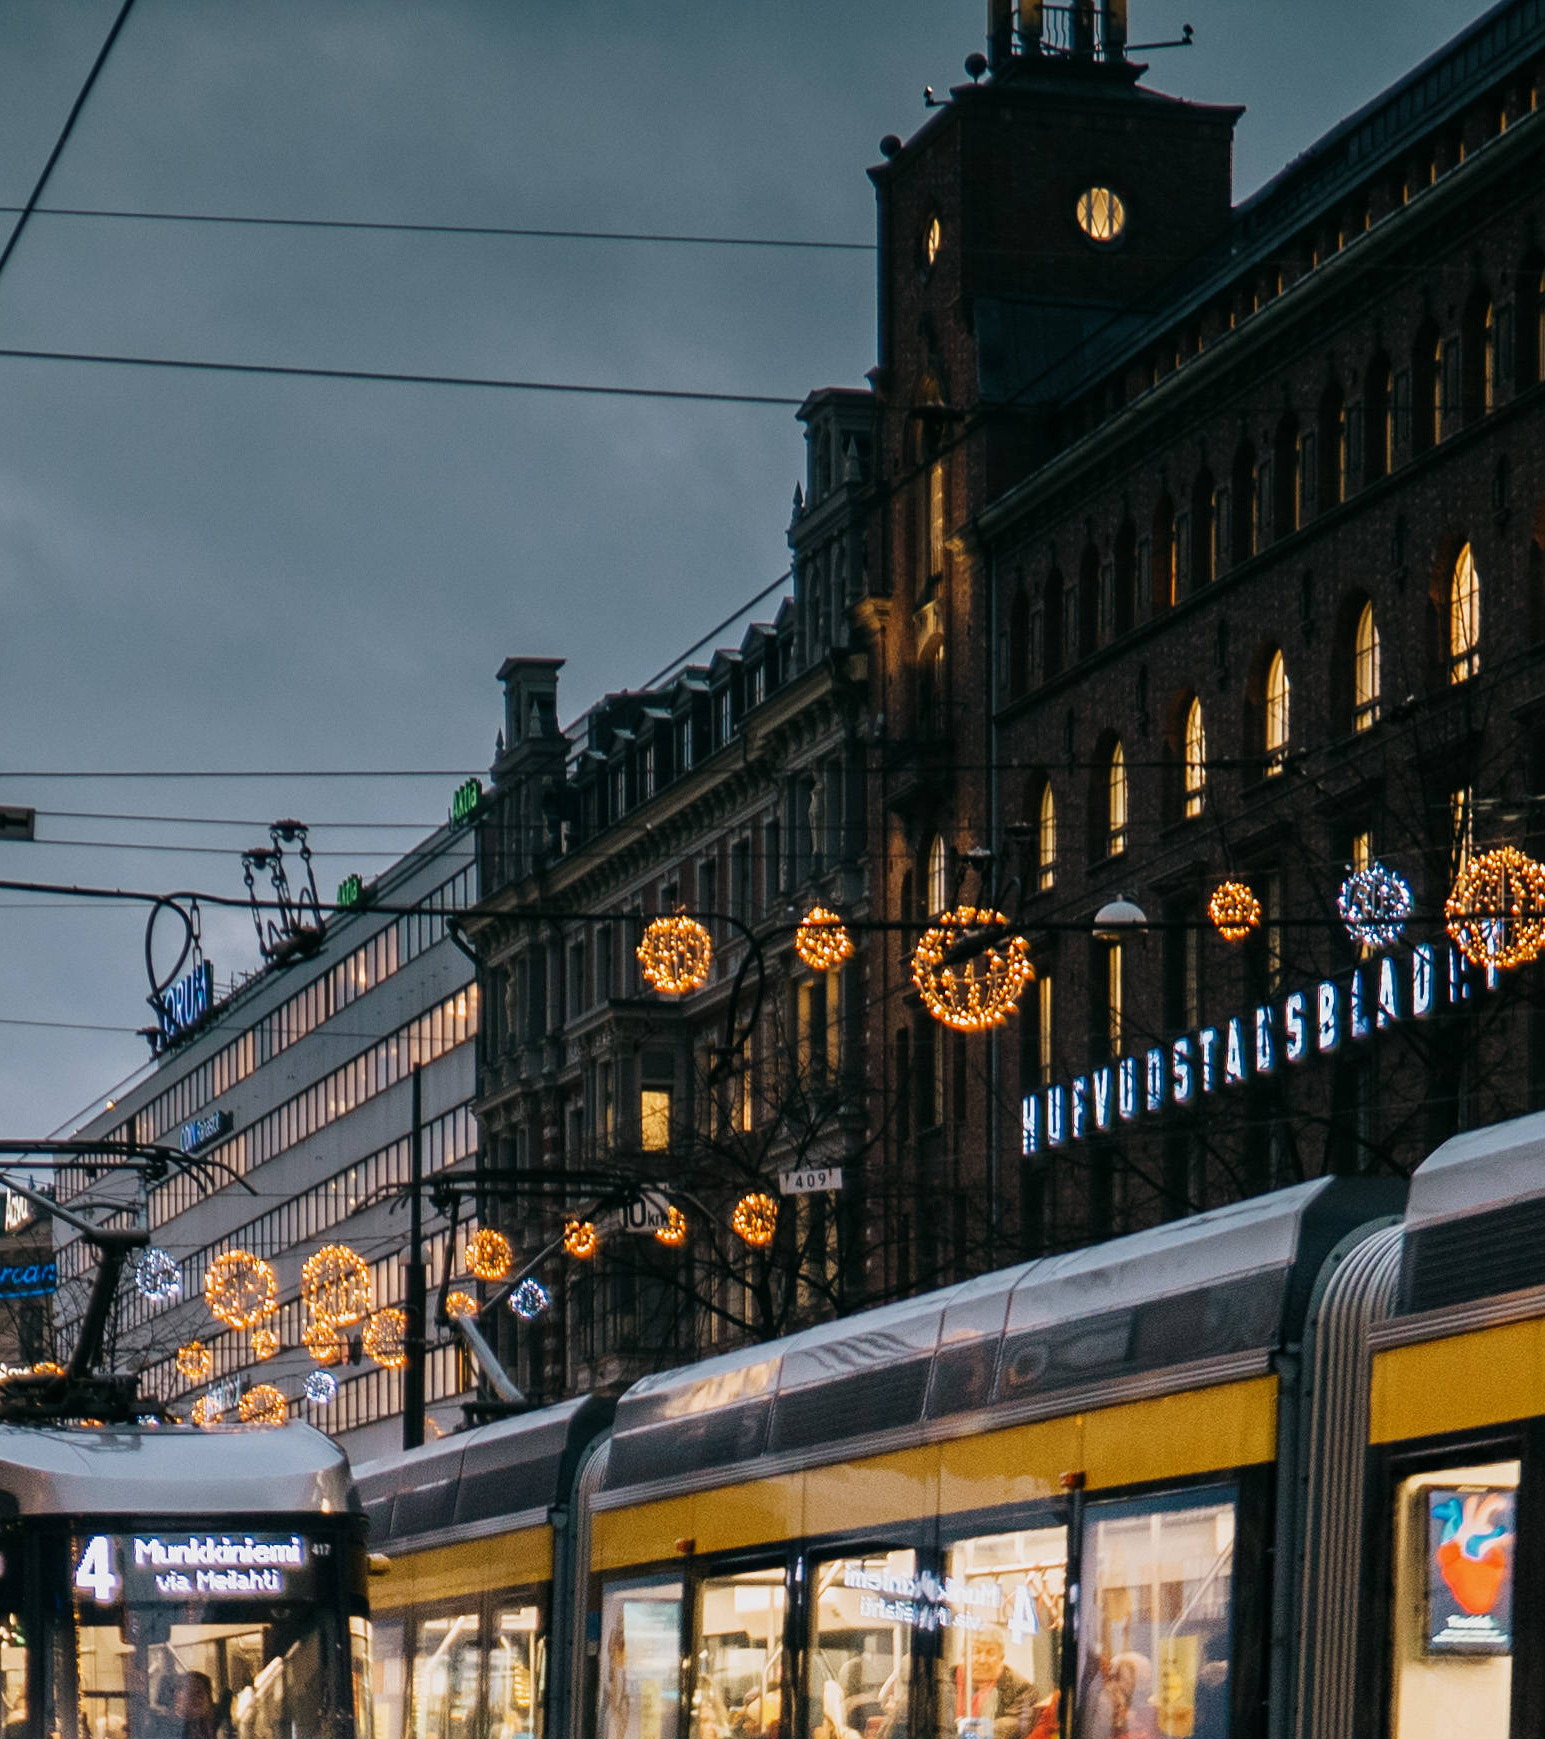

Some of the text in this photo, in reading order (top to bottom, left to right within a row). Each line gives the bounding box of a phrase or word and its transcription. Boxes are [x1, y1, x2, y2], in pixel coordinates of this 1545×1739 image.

[156, 966, 207, 1052] ORUM
[795, 1172, 827, 1188] 409
[76, 1535, 116, 1600] 4
[134, 1536, 303, 1564] Munkkiniemi
[156, 1569, 282, 1593] via Meilahti
